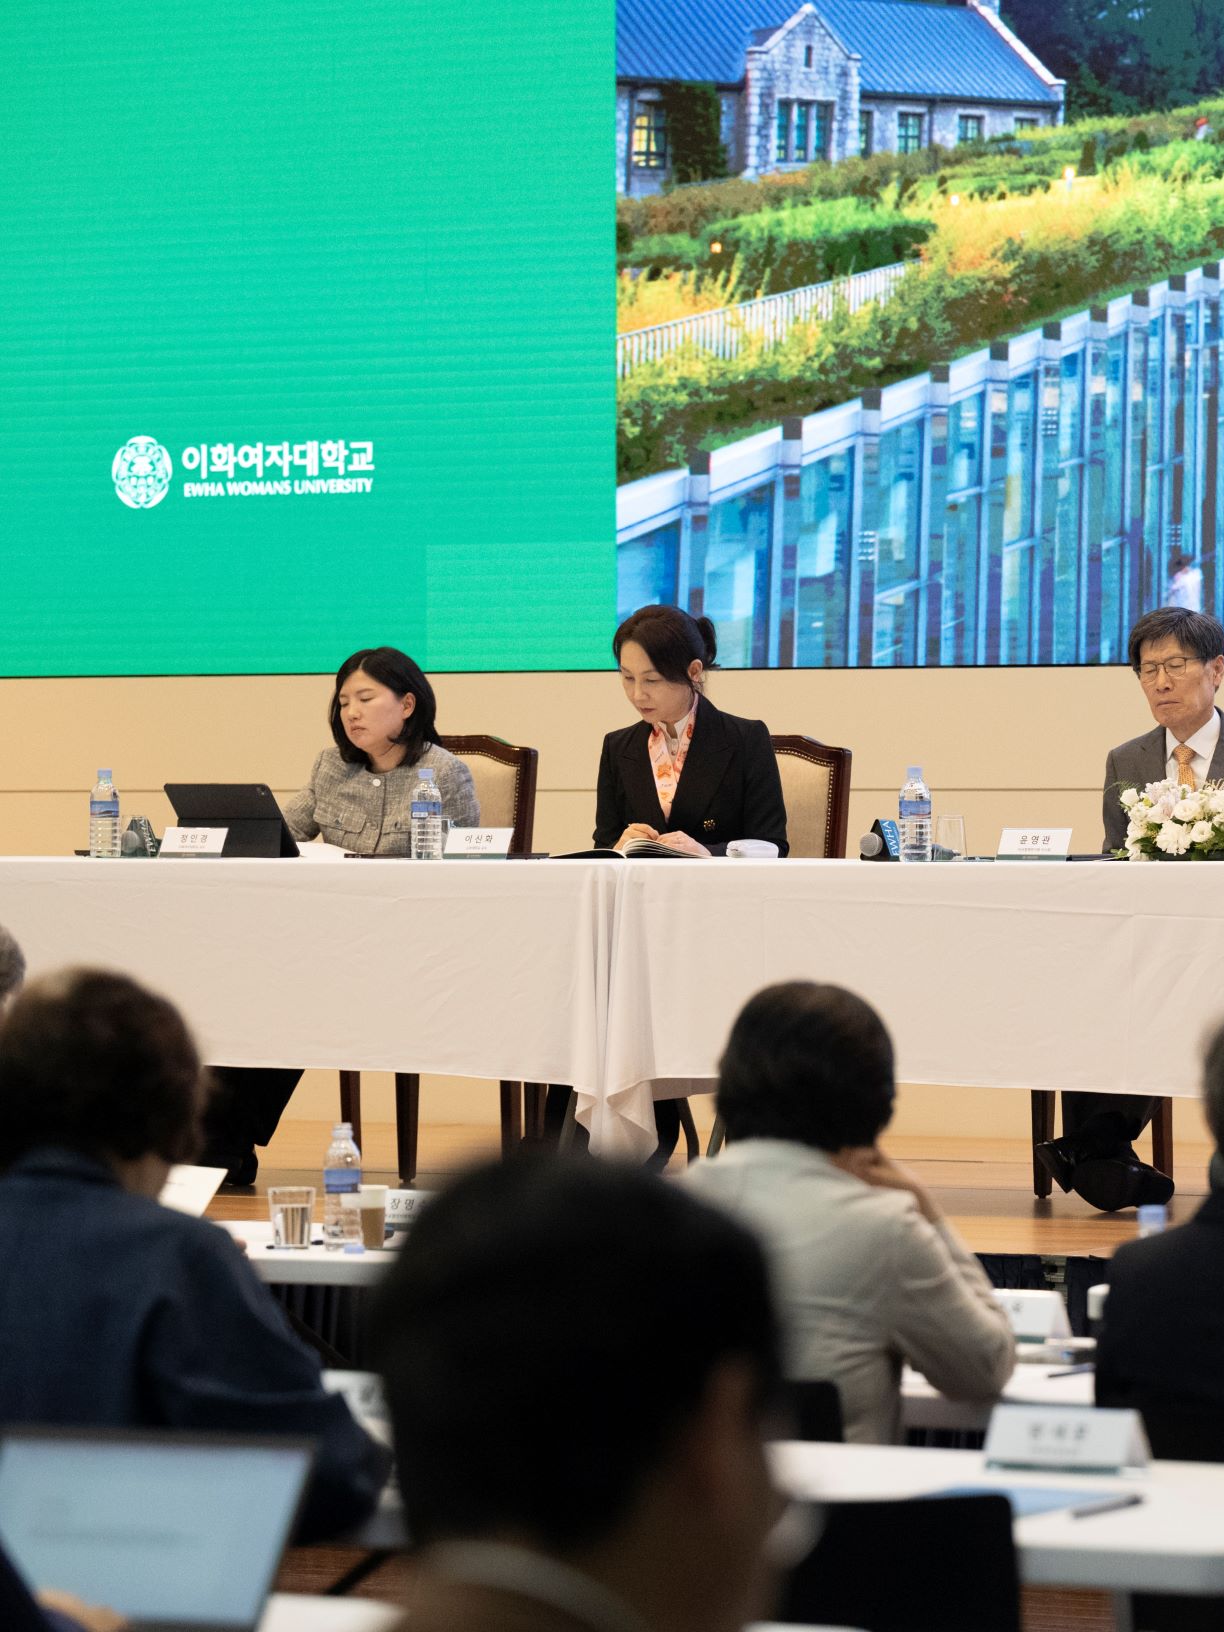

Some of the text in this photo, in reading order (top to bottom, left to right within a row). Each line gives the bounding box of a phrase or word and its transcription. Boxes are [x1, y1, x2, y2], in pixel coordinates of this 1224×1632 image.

[182, 440, 375, 480] 이화여자대학교
[183, 478, 374, 497] EWHA WOMANS UNIVERSITY
[464, 834, 493, 844] 이신화
[882, 821, 900, 856] EWHA
